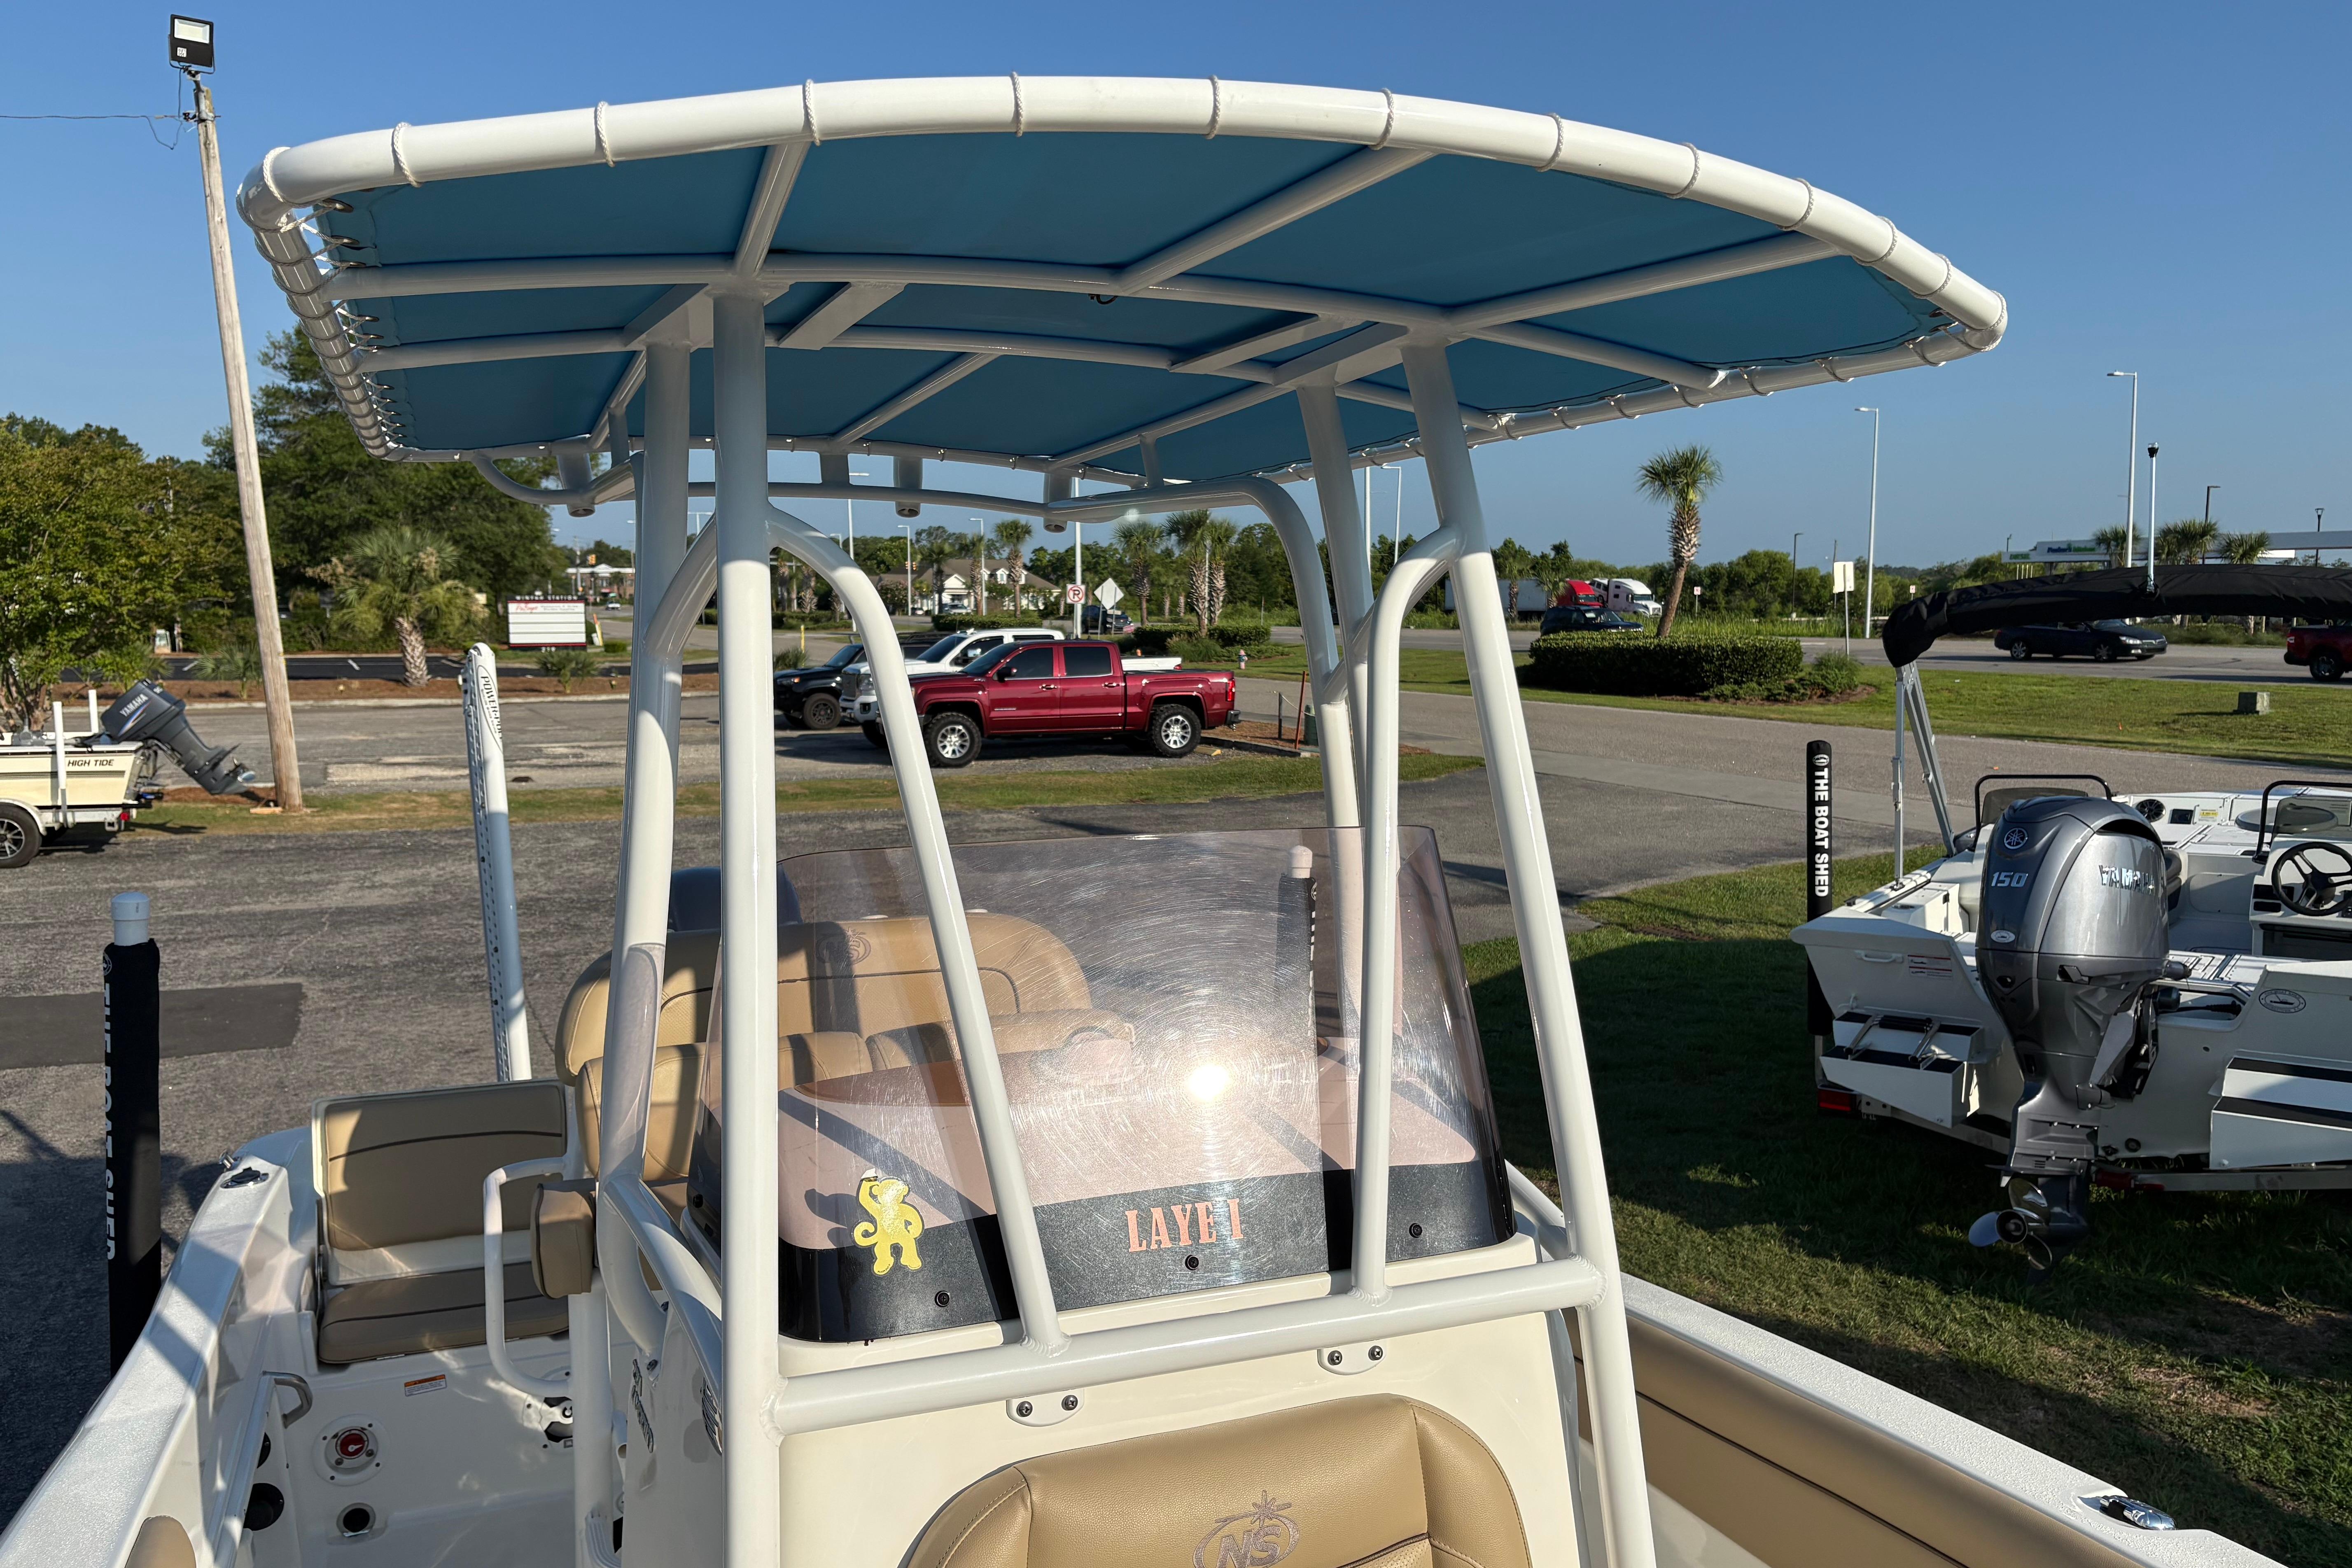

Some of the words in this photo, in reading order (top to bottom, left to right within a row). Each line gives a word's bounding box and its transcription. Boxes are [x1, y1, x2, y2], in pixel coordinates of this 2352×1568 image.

[119, 693, 148, 717] YAMAHA
[1815, 768, 1828, 801] THE
[1815, 806, 1828, 849] BOAT
[1815, 853, 1829, 897] SHED
[1991, 872, 2028, 887] 150
[2098, 865, 2156, 895] YAMAHA
